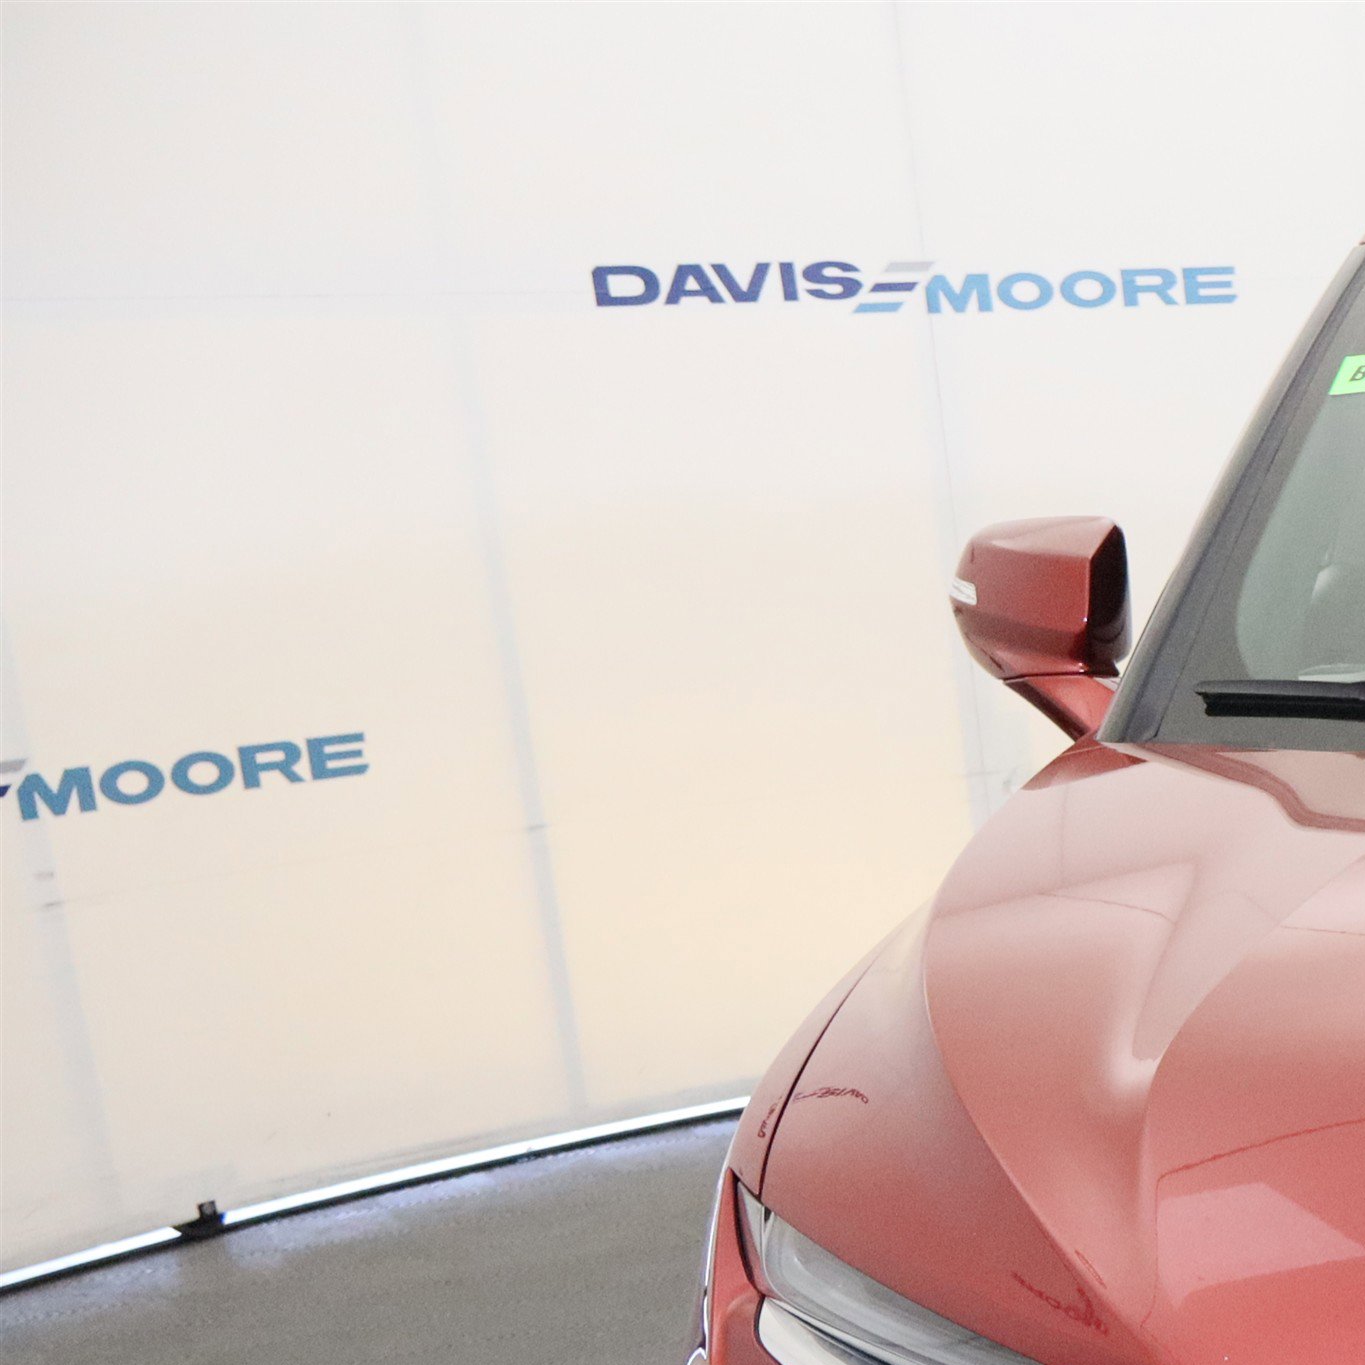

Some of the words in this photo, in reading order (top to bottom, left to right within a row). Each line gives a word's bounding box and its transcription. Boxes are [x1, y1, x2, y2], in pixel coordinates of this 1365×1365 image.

[590, 260, 864, 308] DAVIS
[925, 266, 1238, 314] MOORE
[16, 732, 370, 821] MOORE
